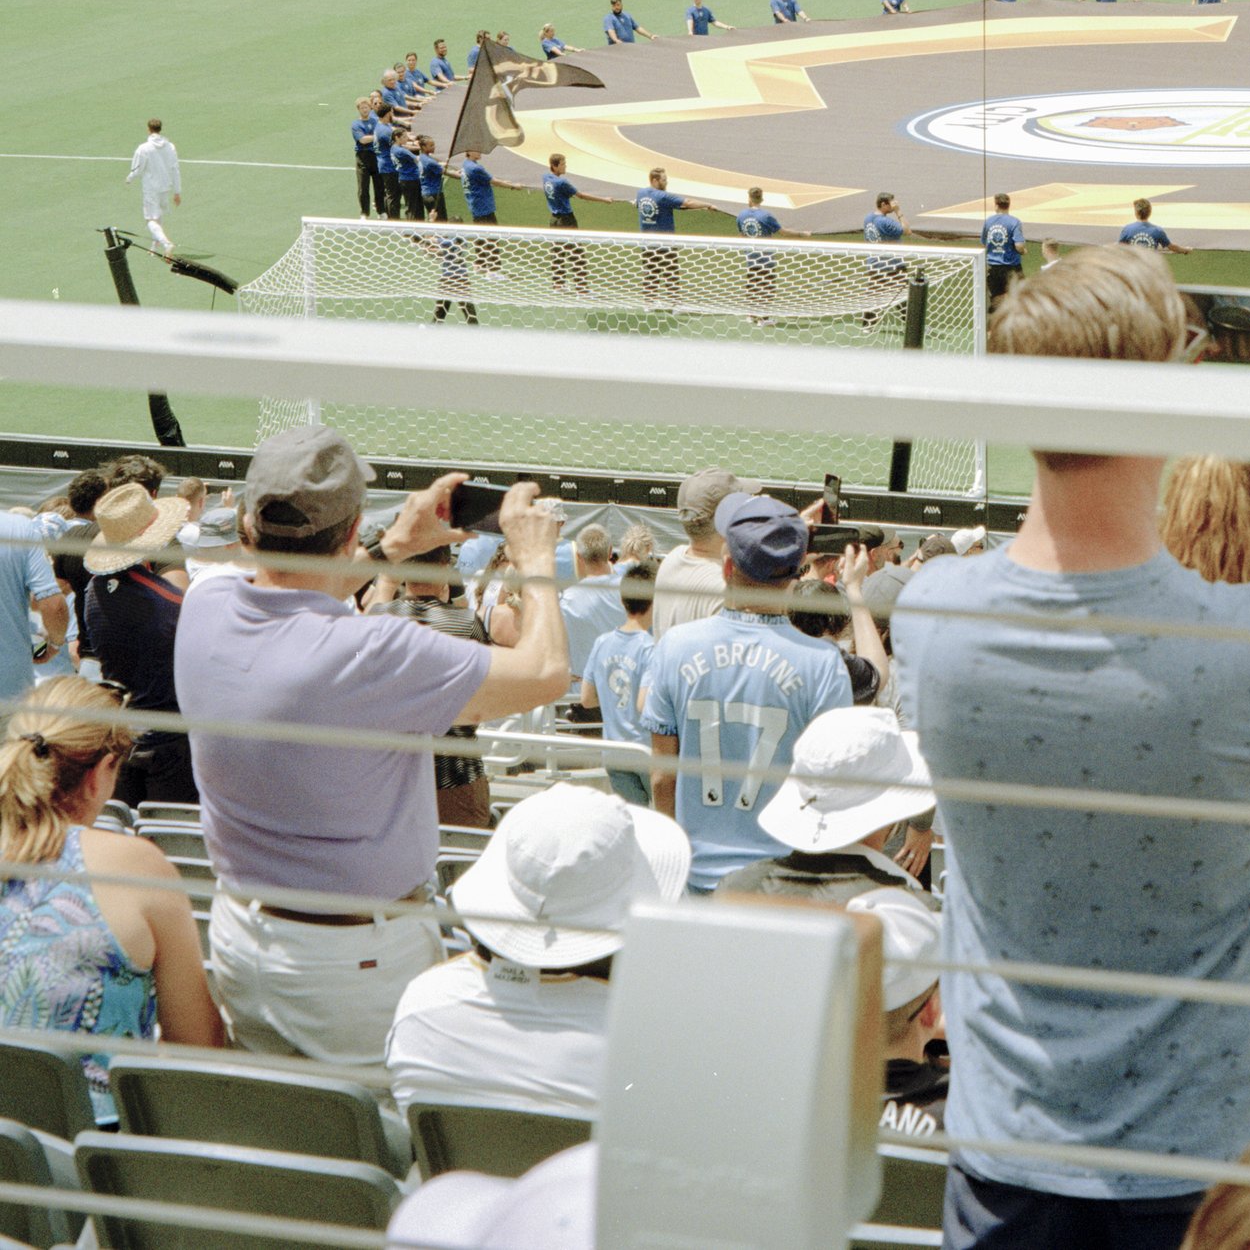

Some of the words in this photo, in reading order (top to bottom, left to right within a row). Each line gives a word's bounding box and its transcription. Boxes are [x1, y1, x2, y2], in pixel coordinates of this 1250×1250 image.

[945, 105, 1039, 130] CITY
[608, 669, 631, 709] 9
[680, 652, 711, 686] DE
[713, 643, 804, 696] BRUYNE
[687, 700, 789, 812] 17
